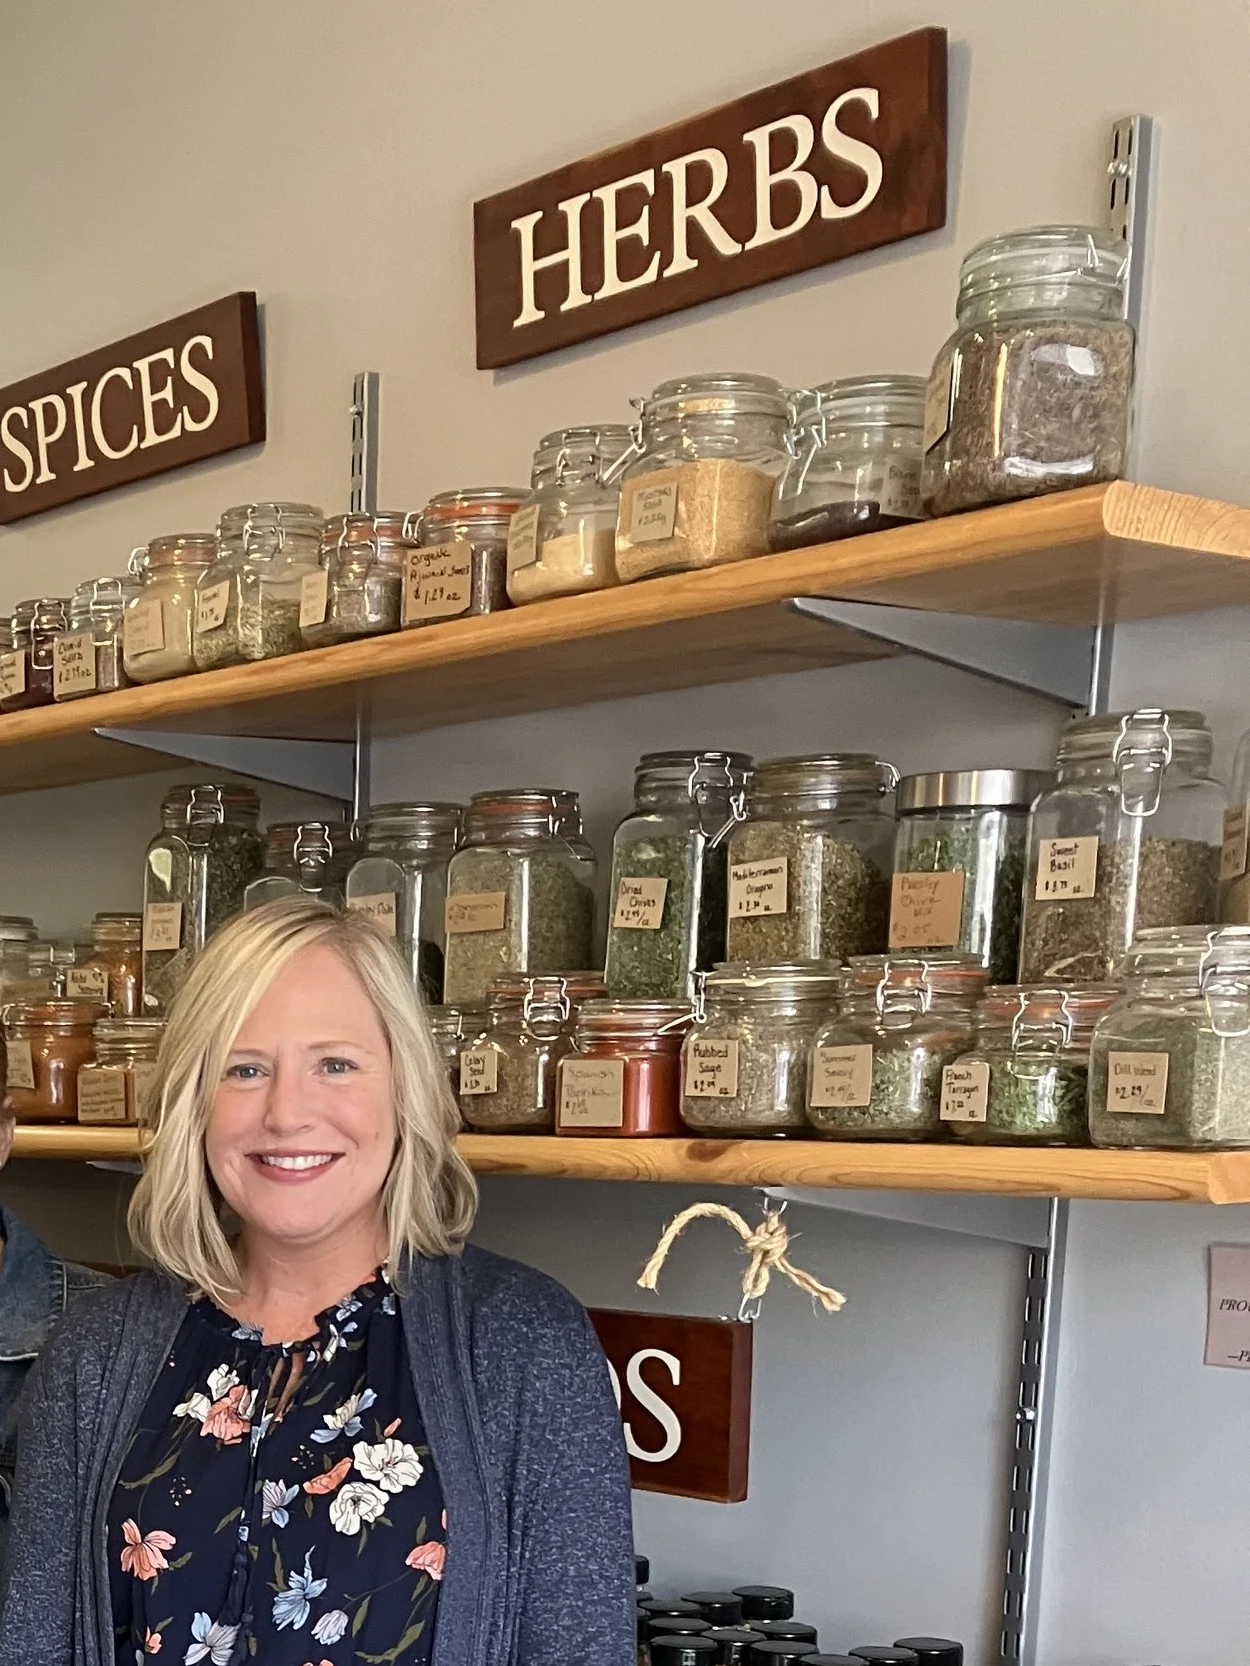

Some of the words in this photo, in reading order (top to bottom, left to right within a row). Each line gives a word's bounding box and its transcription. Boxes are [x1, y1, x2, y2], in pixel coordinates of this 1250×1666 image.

[510, 86, 884, 329] HERBS
[0, 334, 220, 494] SPICES
[1050, 858, 1075, 872] Basil
[620, 879, 643, 895] Dried
[693, 1044, 729, 1059] Rubbed
[698, 1062, 722, 1080] Sage
